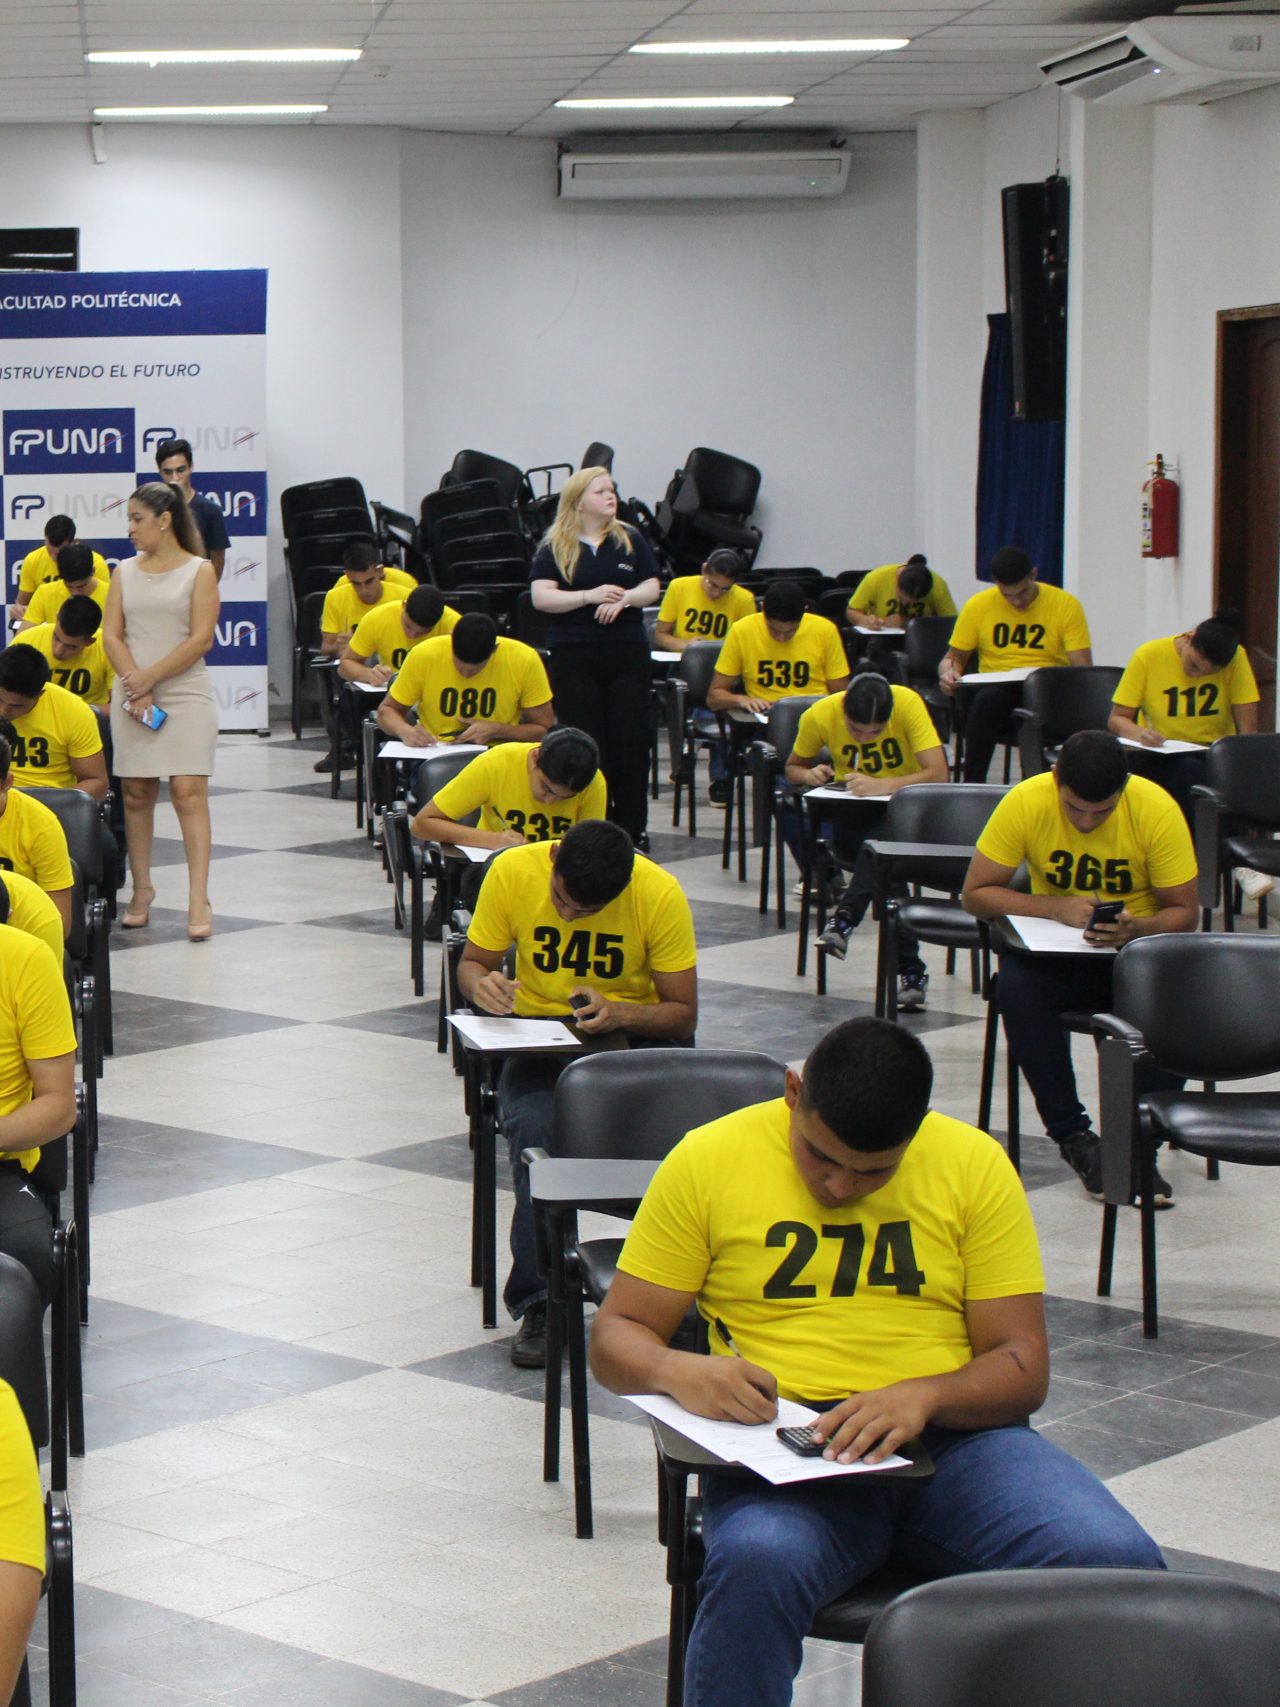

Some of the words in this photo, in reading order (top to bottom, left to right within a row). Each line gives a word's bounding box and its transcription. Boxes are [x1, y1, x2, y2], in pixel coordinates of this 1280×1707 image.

[71, 291, 181, 309] POLITÉCNICA
[109, 364, 127, 378] EL
[133, 362, 201, 378] FUTURO
[684, 608, 728, 638] 290
[993, 622, 1045, 649] 042
[50, 668, 91, 695] 70
[757, 660, 810, 688] 539
[440, 687, 496, 719] 080
[1163, 683, 1219, 717] 112
[10, 737, 50, 768] 43
[841, 737, 904, 774] 259
[1046, 849, 1132, 893] 365
[533, 926, 624, 979] 345
[762, 1220, 926, 1299] 274
